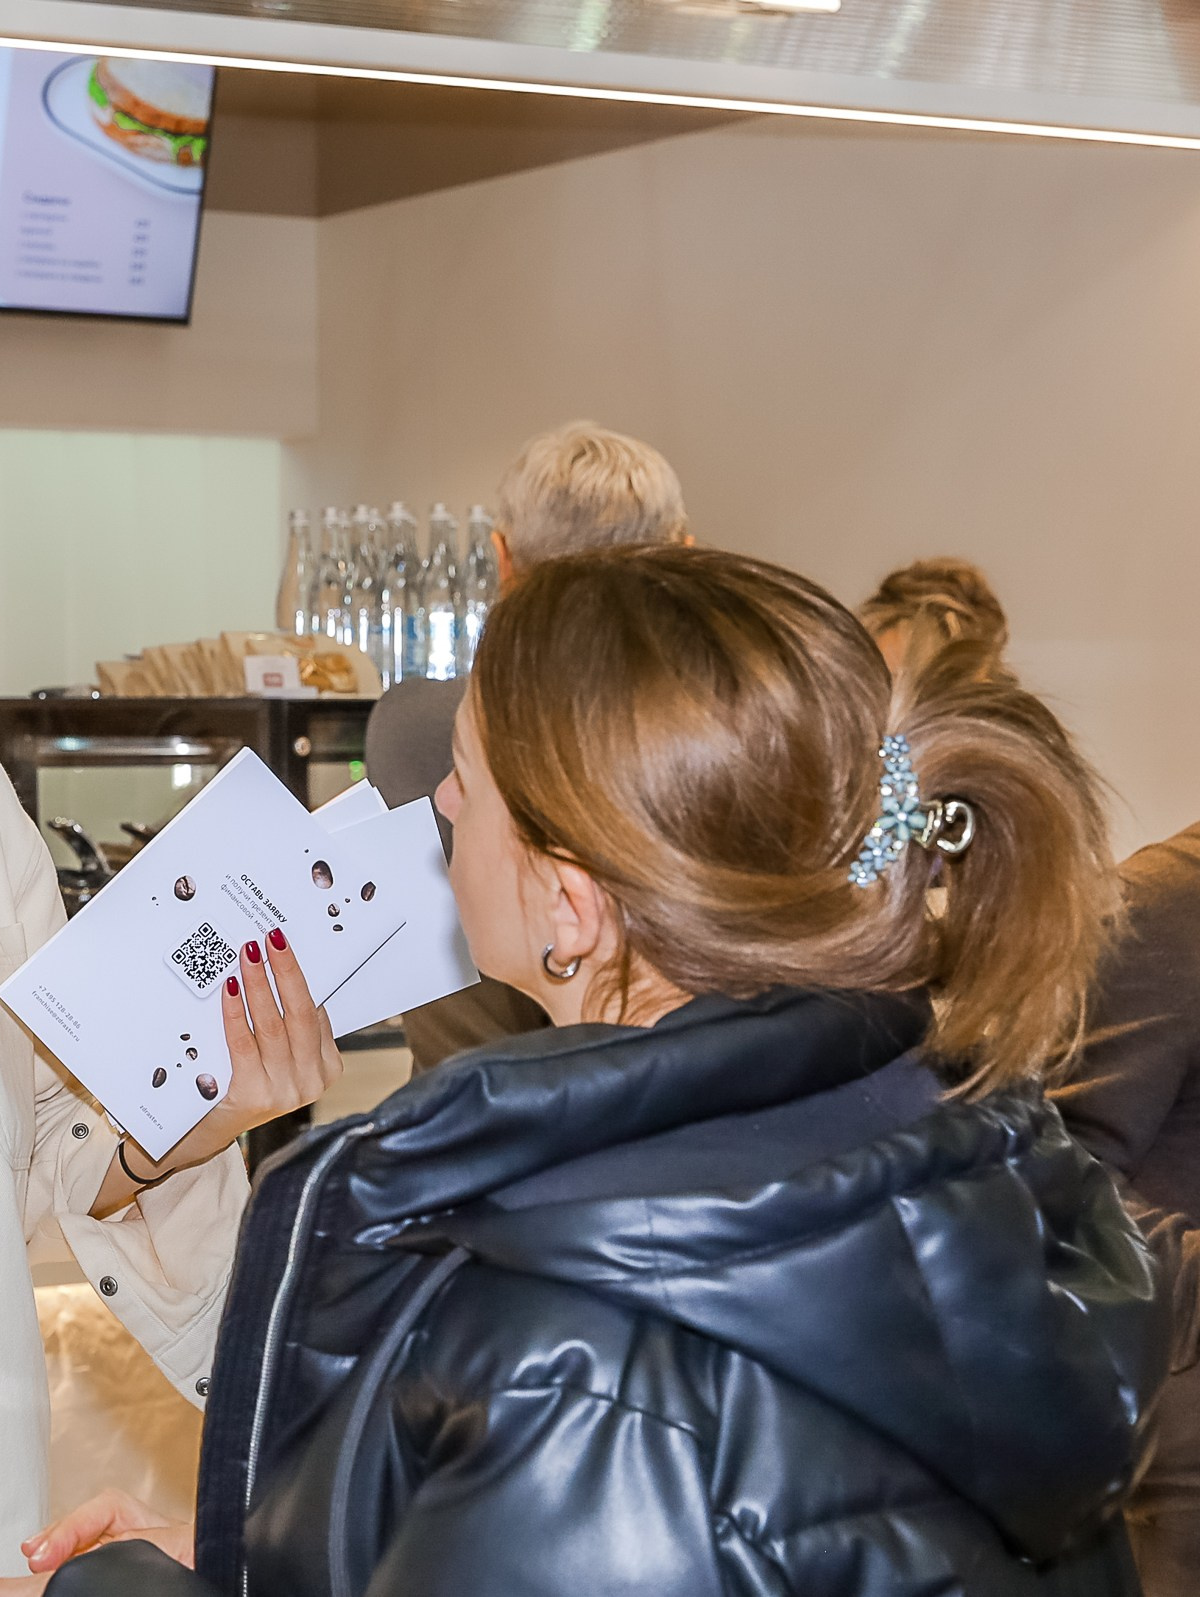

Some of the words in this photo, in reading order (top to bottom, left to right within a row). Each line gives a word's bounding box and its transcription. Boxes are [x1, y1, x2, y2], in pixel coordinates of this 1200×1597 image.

[220, 883, 254, 919] финансовой
[231, 879, 251, 901] получи
[240, 874, 264, 900] ОСТАВЬ
[263, 898, 288, 922] ЗАЯВКУ
